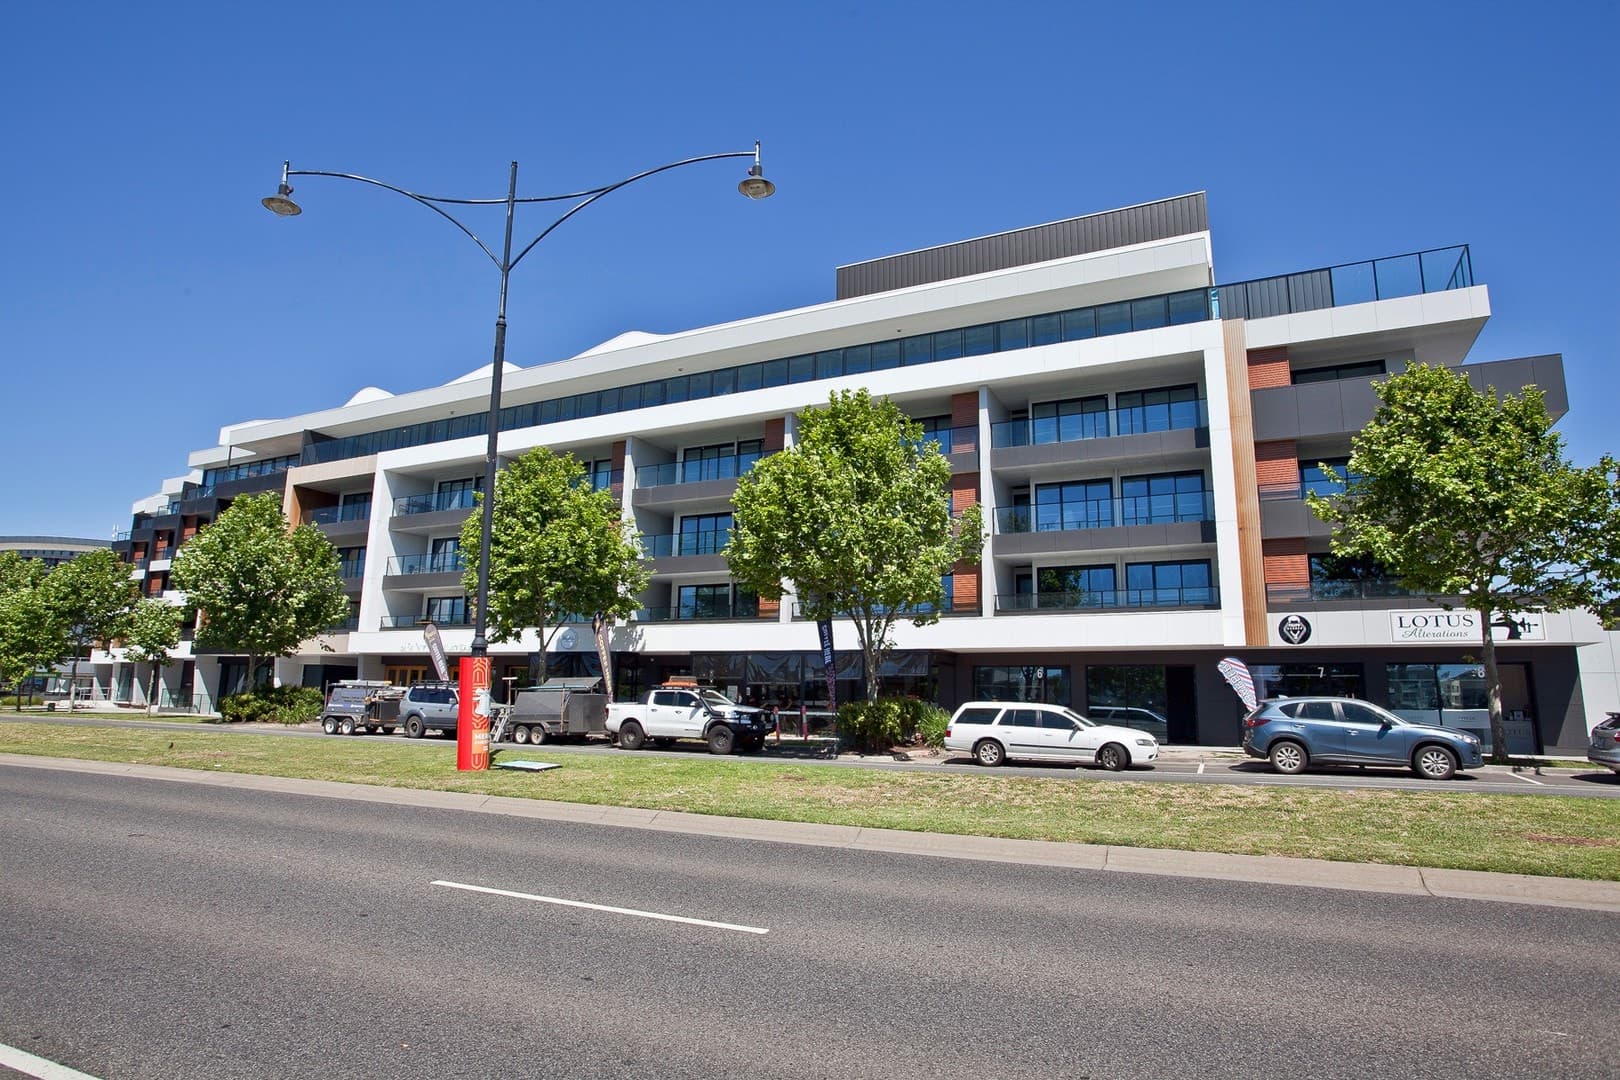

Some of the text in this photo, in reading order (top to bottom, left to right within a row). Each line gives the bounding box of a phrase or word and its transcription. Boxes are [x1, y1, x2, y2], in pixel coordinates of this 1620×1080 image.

[1398, 614, 1474, 629] LOTUS
[1402, 626, 1469, 639] Alterations
[1037, 668, 1043, 679] 6
[1317, 666, 1324, 678] 7
